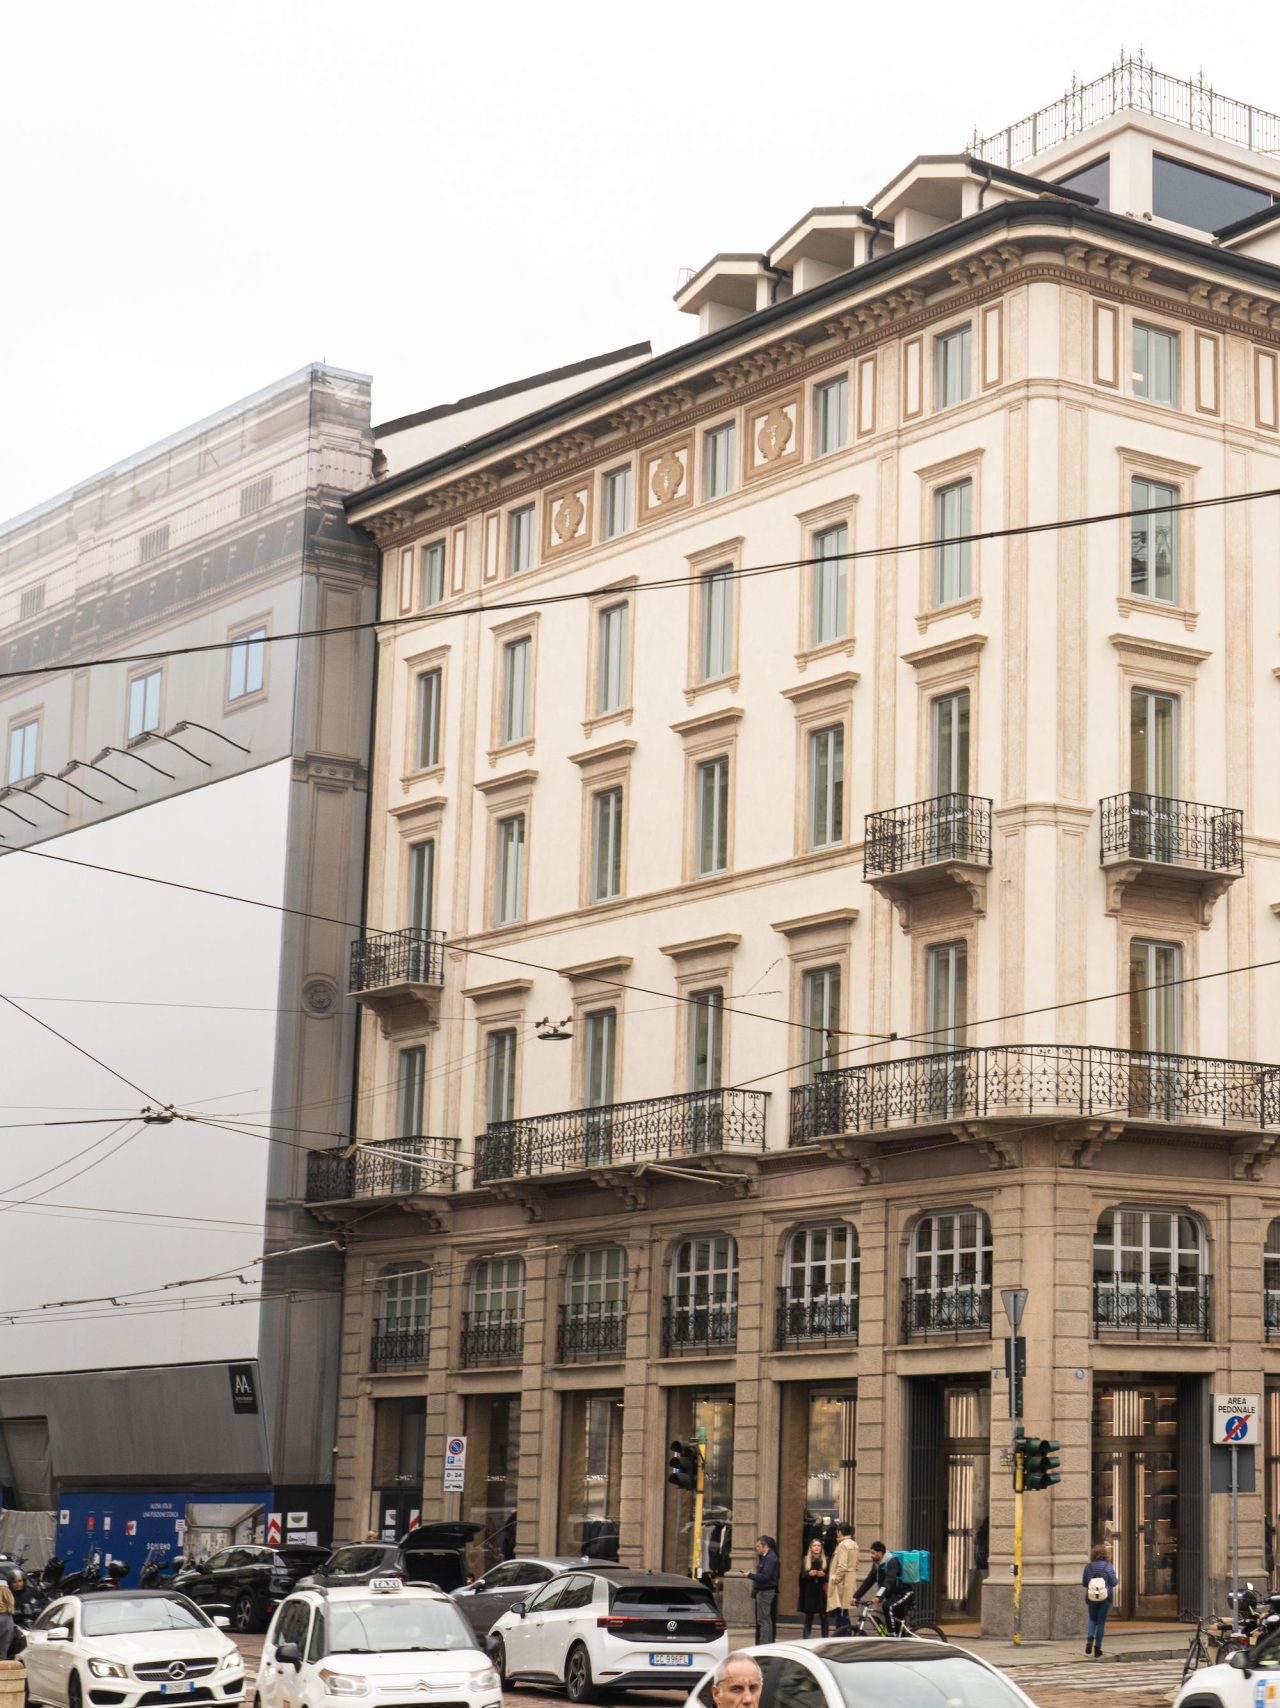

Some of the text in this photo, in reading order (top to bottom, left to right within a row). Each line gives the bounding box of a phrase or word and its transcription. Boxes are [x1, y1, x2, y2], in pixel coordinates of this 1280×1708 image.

[1227, 1397, 1247, 1405] AREA
[1218, 1405, 1256, 1414] PEDONALE
[374, 1580, 399, 1588] TAXI
